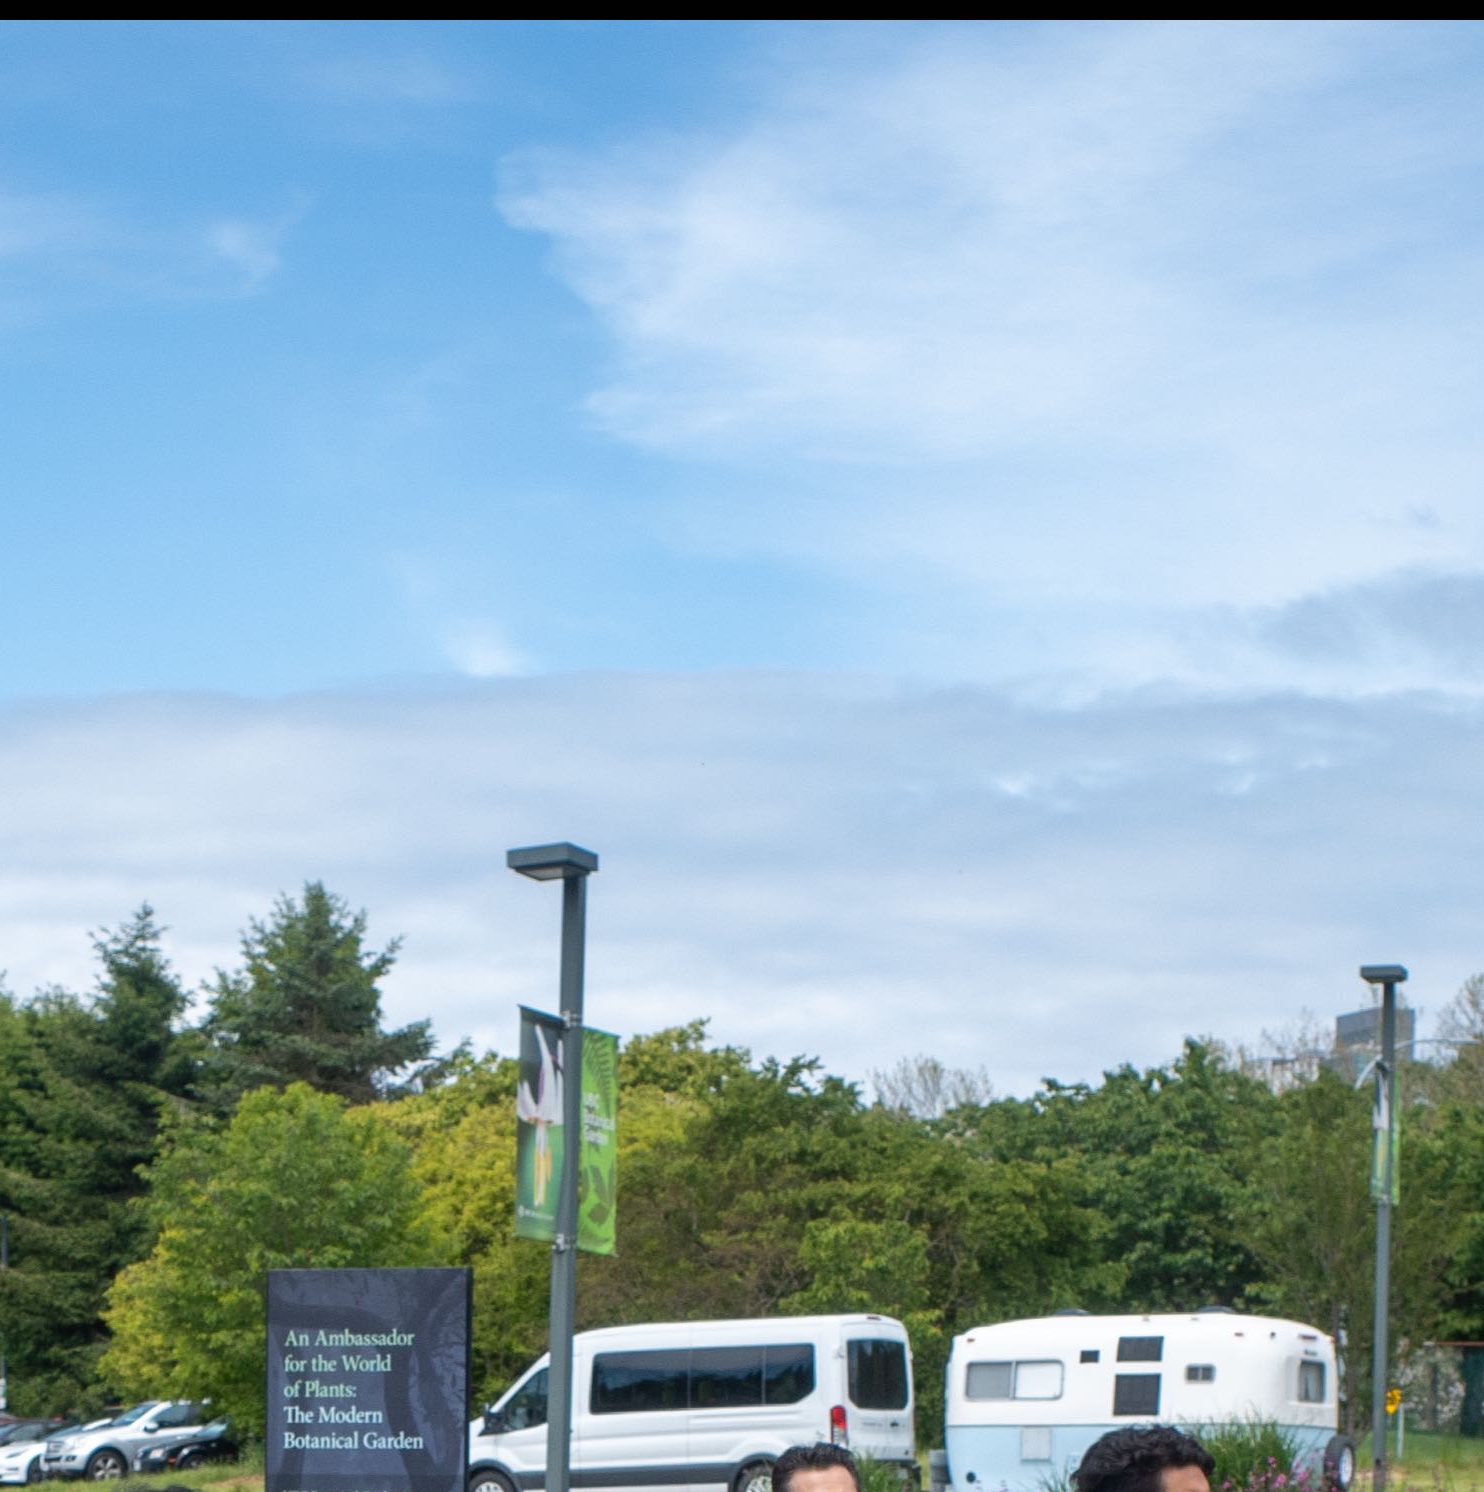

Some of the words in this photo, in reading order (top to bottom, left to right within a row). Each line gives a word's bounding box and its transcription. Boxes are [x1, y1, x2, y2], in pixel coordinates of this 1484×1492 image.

[285, 1330, 309, 1346] An
[315, 1328, 414, 1346] Ambassador
[284, 1355, 306, 1372] for
[312, 1355, 336, 1371] the
[342, 1354, 391, 1371] World
[284, 1380, 301, 1398] of
[305, 1380, 357, 1397] Plants:
[283, 1406, 314, 1423] The
[318, 1406, 383, 1423] Modern
[284, 1432, 358, 1449] Botanical
[363, 1431, 423, 1449] Garden
